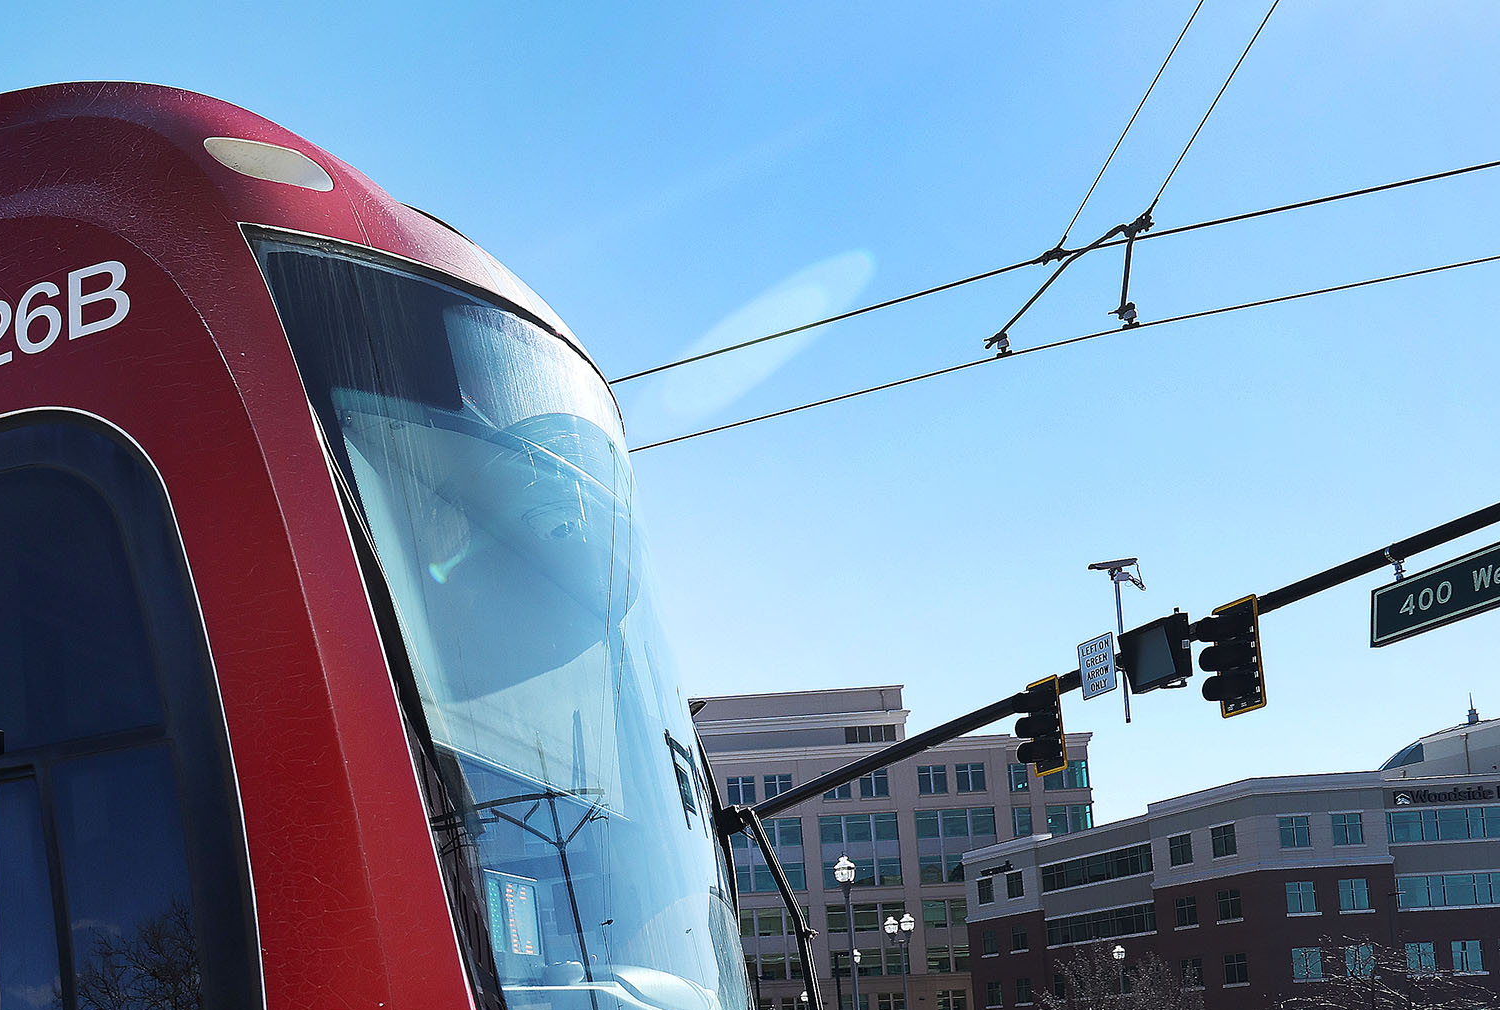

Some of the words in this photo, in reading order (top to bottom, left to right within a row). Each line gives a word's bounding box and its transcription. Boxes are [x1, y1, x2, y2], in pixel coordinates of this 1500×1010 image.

[1399, 581, 1453, 616] 400
[1081, 643, 1098, 657] LEFT
[1099, 639, 1109, 651] ON
[1085, 652, 1108, 668] GREEN
[1086, 664, 1110, 681] ARROW
[1090, 679, 1108, 692] ONLY
[1410, 785, 1494, 804] Woodside
